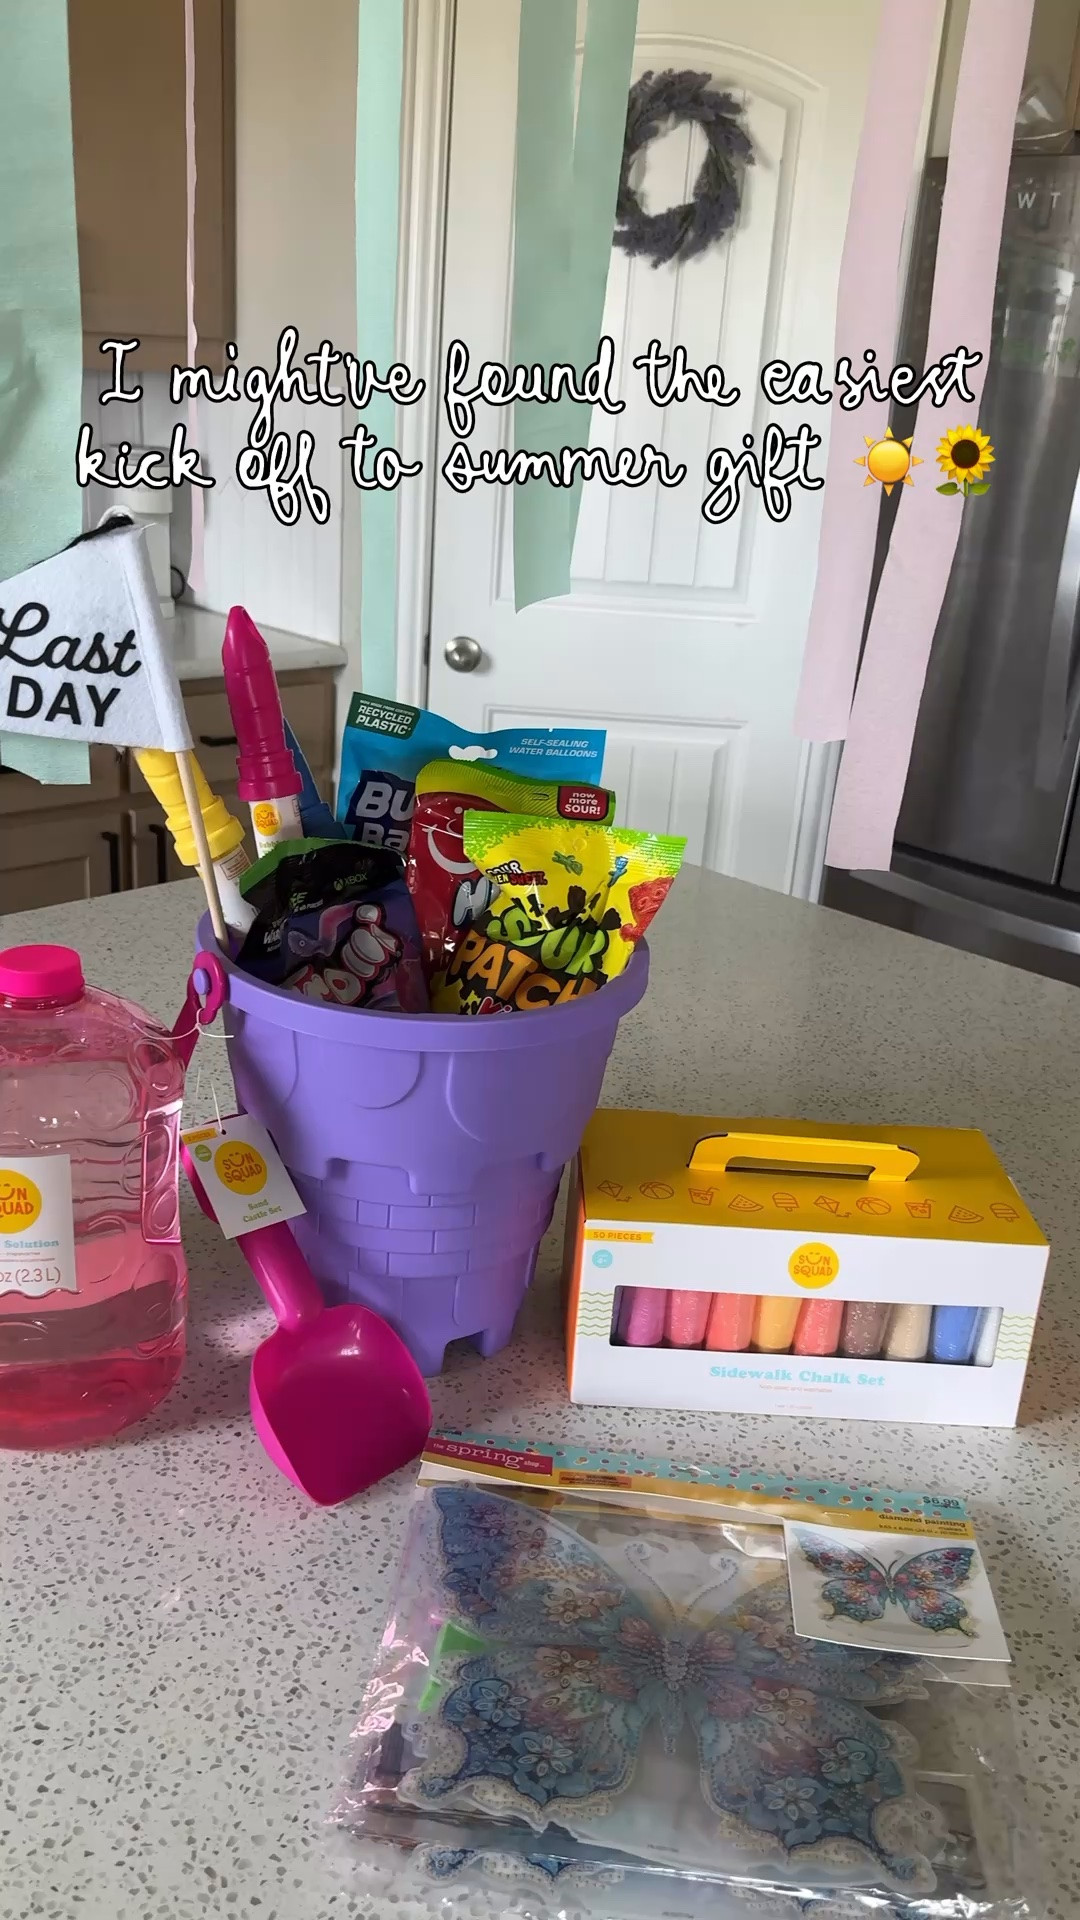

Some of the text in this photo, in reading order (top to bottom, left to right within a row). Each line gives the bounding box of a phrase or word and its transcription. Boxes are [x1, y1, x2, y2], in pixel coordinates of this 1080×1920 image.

[0, 602, 142, 677] Last
[6, 675, 121, 728] DAY
[358, 705, 412, 725] RECYCLED
[520, 738, 589, 748] SELF-SEALING
[508, 746, 598, 758] WATER BALLOONS
[564, 804, 601, 815] SOUR!
[568, 798, 598, 806] more
[486, 905, 609, 975] SOUR
[450, 930, 598, 1011] PATCH
[222, 1152, 255, 1170] SUN
[224, 1164, 263, 1183] SQUAD
[0, 1188, 27, 1200] UN
[0, 1202, 34, 1218] UAD
[248, 1198, 269, 1210] Sand
[243, 1205, 282, 1223] Castle Set
[593, 1231, 642, 1241] 50 PIECES
[4, 1239, 59, 1249] Solution
[798, 1255, 831, 1266] SUN
[15, 1269, 43, 1287] (2.3
[46, 1266, 61, 1285] L)
[793, 1265, 833, 1278] SQUAD
[709, 1365, 885, 1386] Sidewalk Chalk Set
[433, 1442, 444, 1450] the
[446, 1444, 525, 1469] spring
[922, 1496, 958, 1506] $6.99
[878, 1513, 966, 1528] diamond painting
